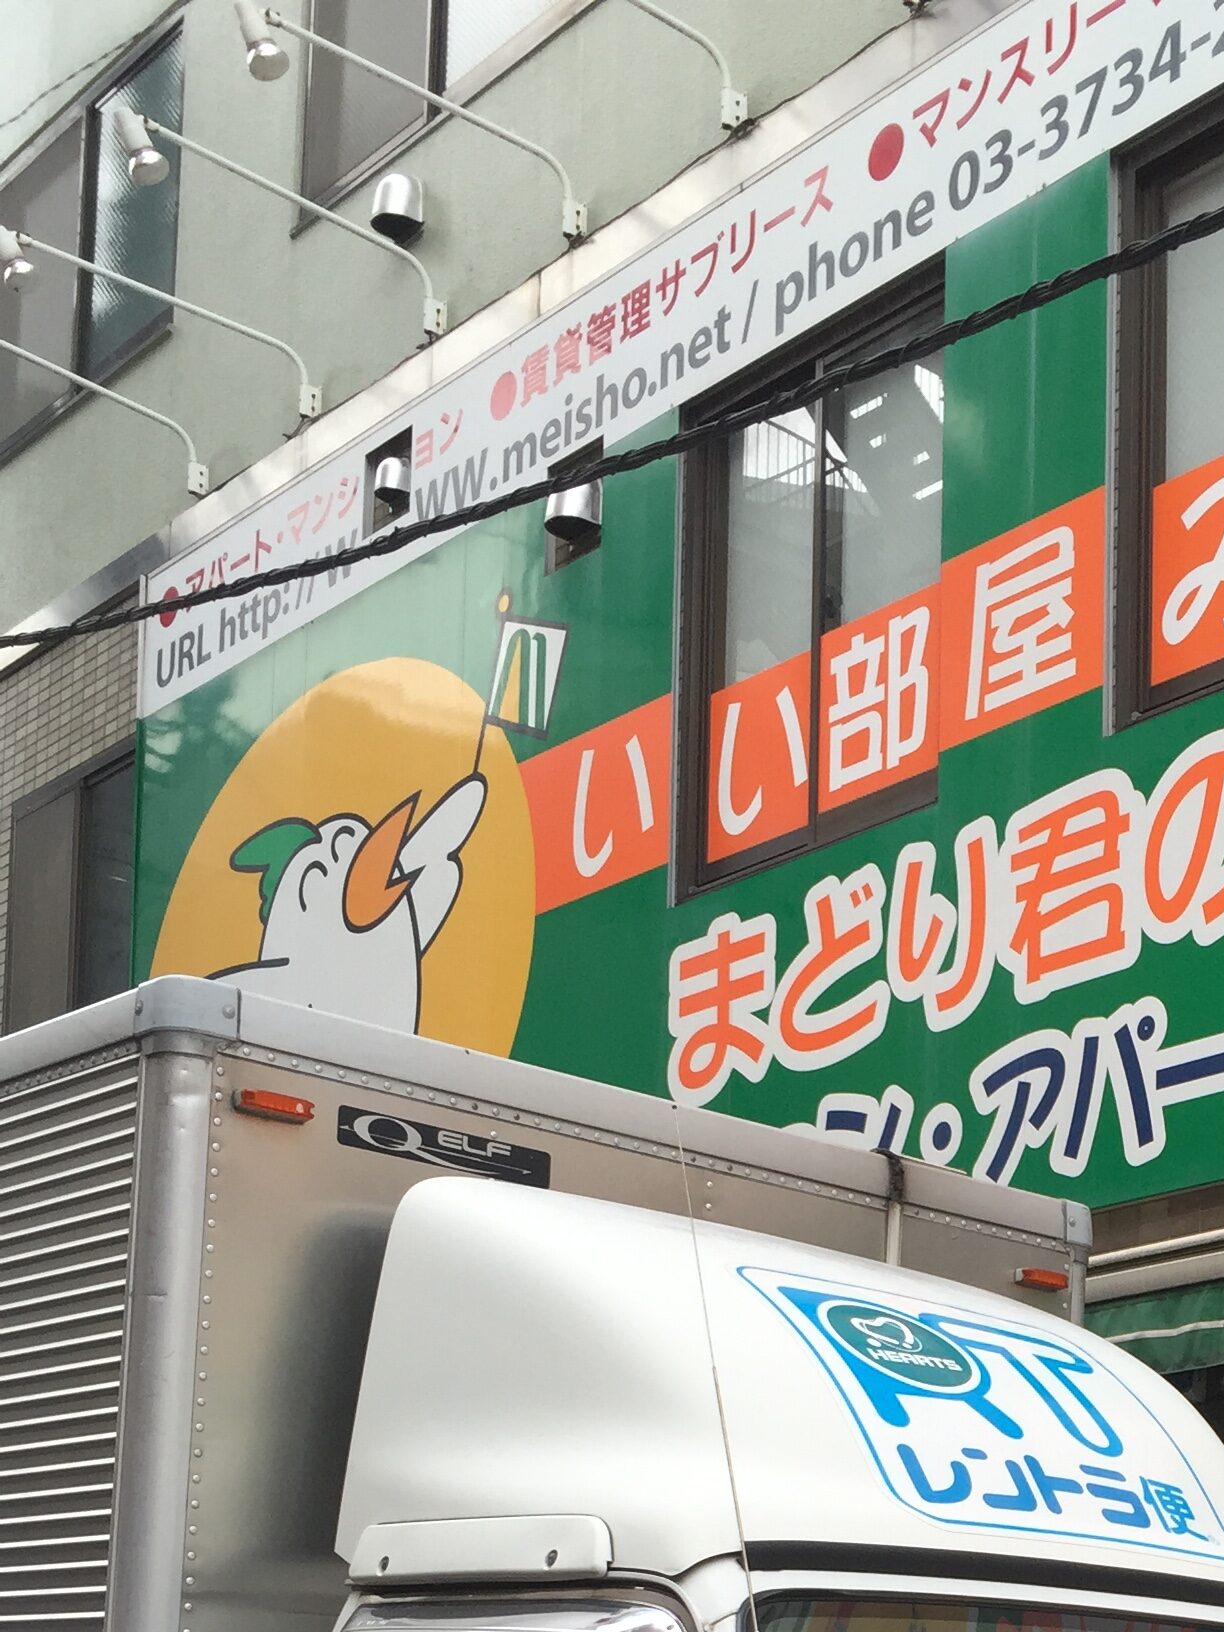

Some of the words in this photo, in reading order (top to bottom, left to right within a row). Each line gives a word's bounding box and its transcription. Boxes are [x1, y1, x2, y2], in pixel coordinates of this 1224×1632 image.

[519, 163, 834, 413] 賃貸管理サブリース
[156, 623, 212, 688] URL
[773, 184, 935, 336] phone
[437, 1130, 512, 1158] ELF
[869, 1346, 963, 1376] HEARTS
[896, 1443, 1222, 1545] レントラ便
